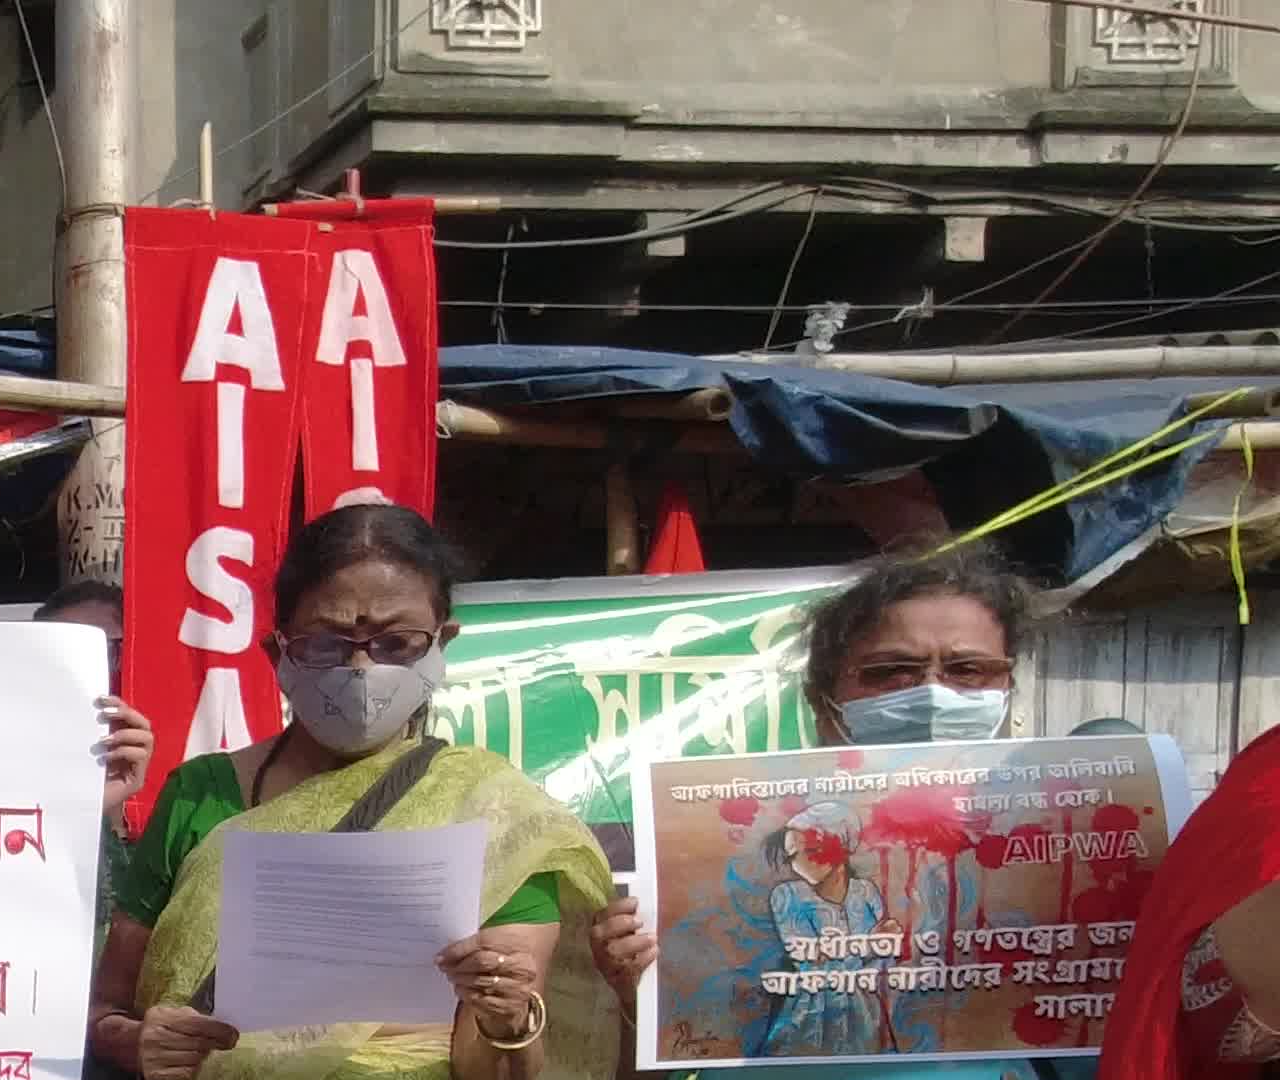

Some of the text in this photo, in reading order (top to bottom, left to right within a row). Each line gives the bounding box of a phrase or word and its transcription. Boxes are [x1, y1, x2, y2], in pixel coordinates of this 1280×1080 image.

[670, 776, 809, 801] আফগানিস্তানের
[815, 770, 888, 793] নারীদের
[893, 767, 989, 787] অধিকারের
[951, 795, 1012, 814] হামলা
[1002, 830, 1150, 867] AIPWA
[784, 920, 1137, 962] স্বাধীনতা ও গণতন্ত্রের জন
[761, 968, 881, 997] আফগান
[887, 959, 1003, 993] নারীদের
